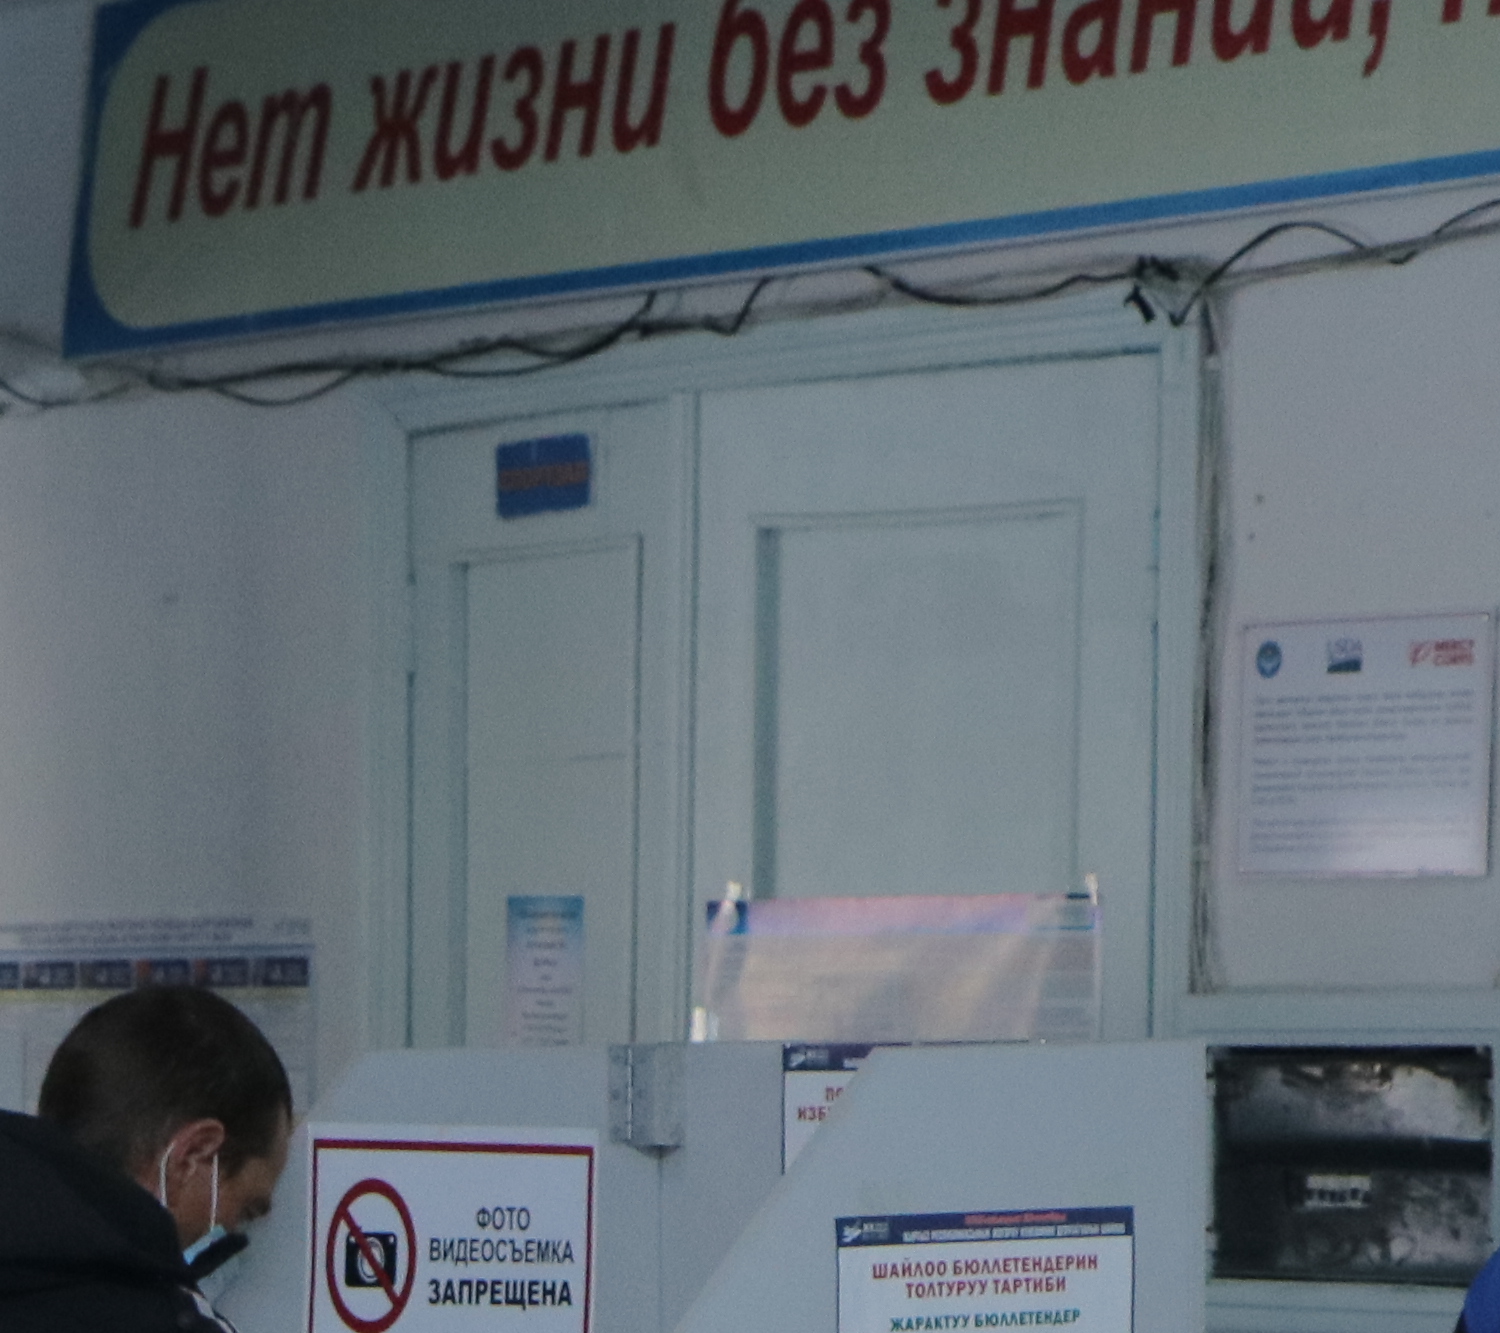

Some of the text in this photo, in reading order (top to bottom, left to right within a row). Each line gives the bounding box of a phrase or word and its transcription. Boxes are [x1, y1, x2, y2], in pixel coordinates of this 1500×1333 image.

[129, 66, 332, 229] Нет
[351, 22, 676, 193] жизни
[708, 0, 892, 137] без
[797, 1106, 830, 1121] ИЗБ
[475, 1206, 531, 1233] ФОТО
[428, 1236, 575, 1266] ВИДЕОСЪЕМКА
[872, 1254, 1098, 1280] ШАЙЛОО БЮЛЛЕТЕНДЕРИН
[427, 1279, 573, 1311] ЗАПРЕЩЕНА
[905, 1276, 1067, 1299] ТОЛТУРУУ ТАРТИБИ
[890, 1308, 1081, 1332] ЖАРАКТУУ БЮЛЛЕТЕНДЕР
